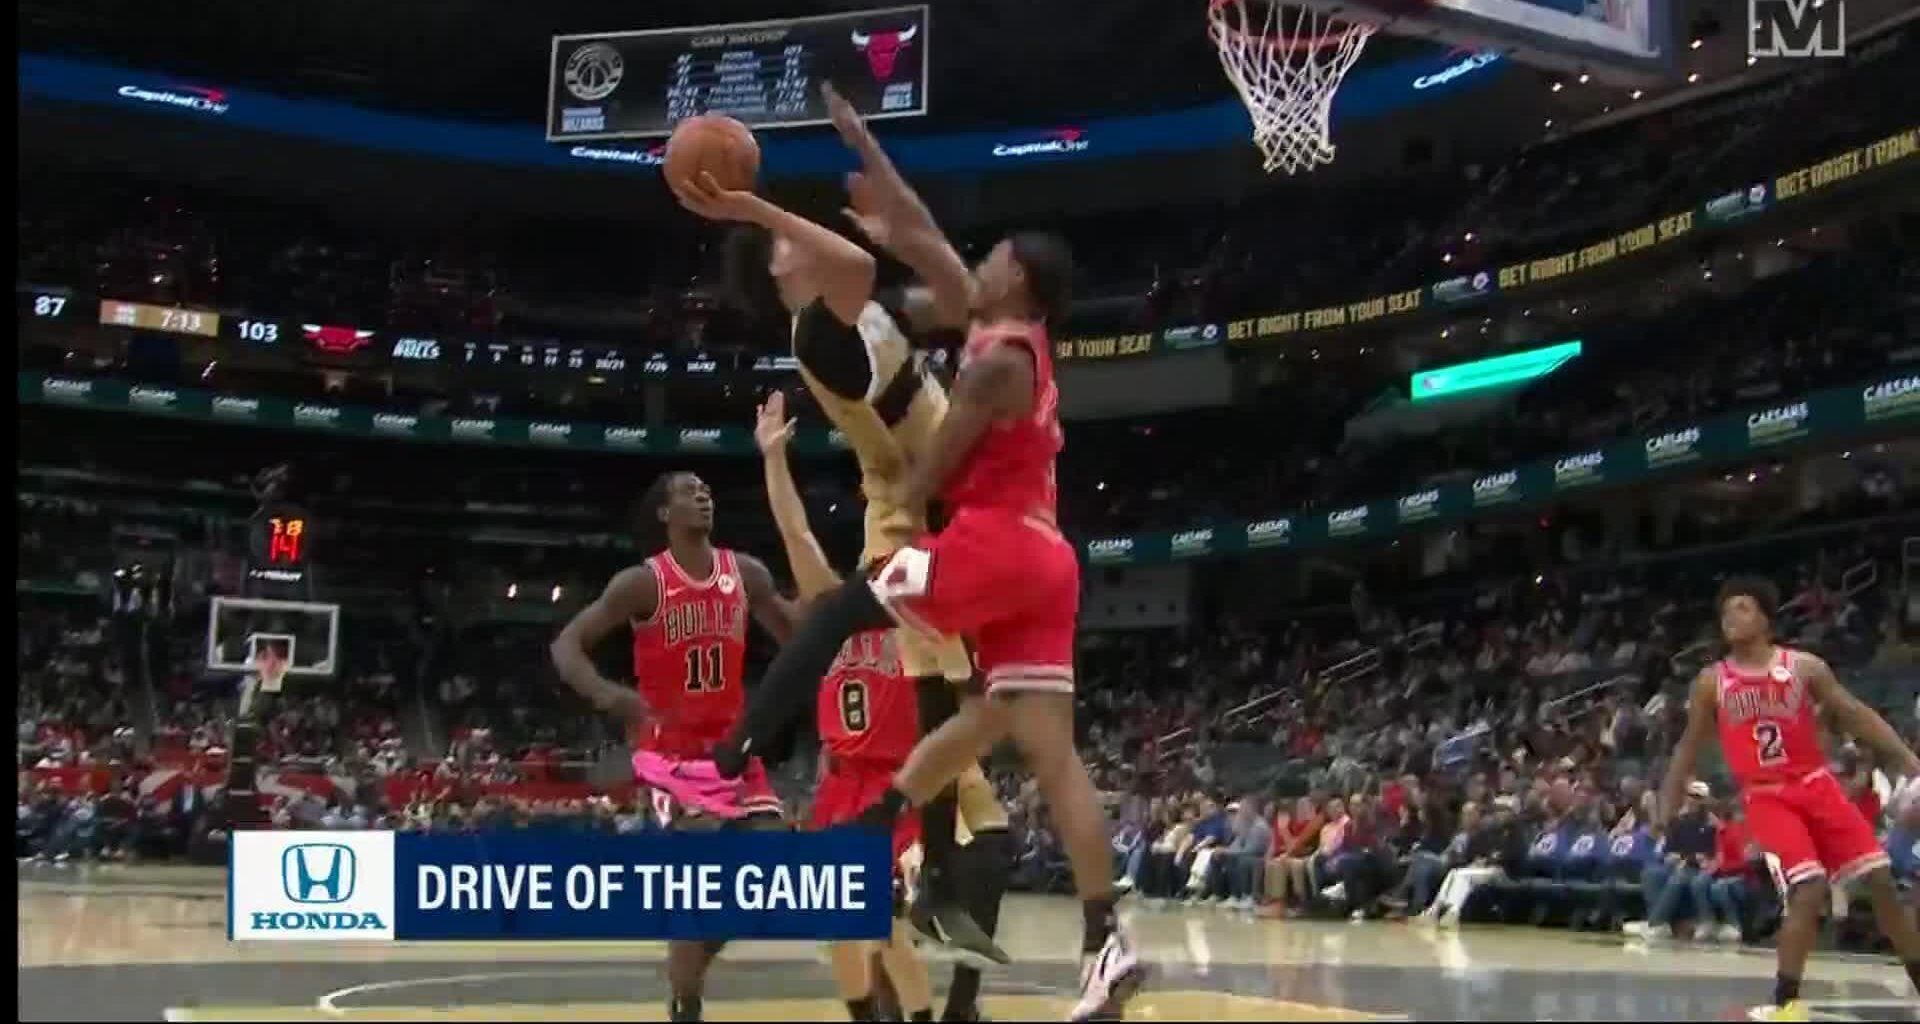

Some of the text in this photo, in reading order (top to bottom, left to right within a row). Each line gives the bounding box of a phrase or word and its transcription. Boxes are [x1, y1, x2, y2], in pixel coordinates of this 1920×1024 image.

[34, 295, 66, 317] 87
[160, 308, 201, 332] 7:13
[238, 320, 279, 343] 103
[1228, 318, 1254, 340] BET
[1304, 307, 1346, 331] FROM
[1748, 401, 1809, 429] CAESARS
[1645, 427, 1700, 452] CAESARS
[1555, 451, 1604, 474] CAESARS
[1473, 469, 1518, 493] CAESARS
[1400, 488, 1440, 508] CAESARS
[1246, 518, 1290, 534] CAESARS
[1328, 504, 1369, 525] CAESARS
[270, 534, 301, 563] 14
[1088, 537, 1134, 552] CAESARS
[1171, 528, 1214, 546] CAESARS
[684, 643, 726, 693] 11
[838, 678, 870, 735] 8
[1752, 720, 1788, 767] 2
